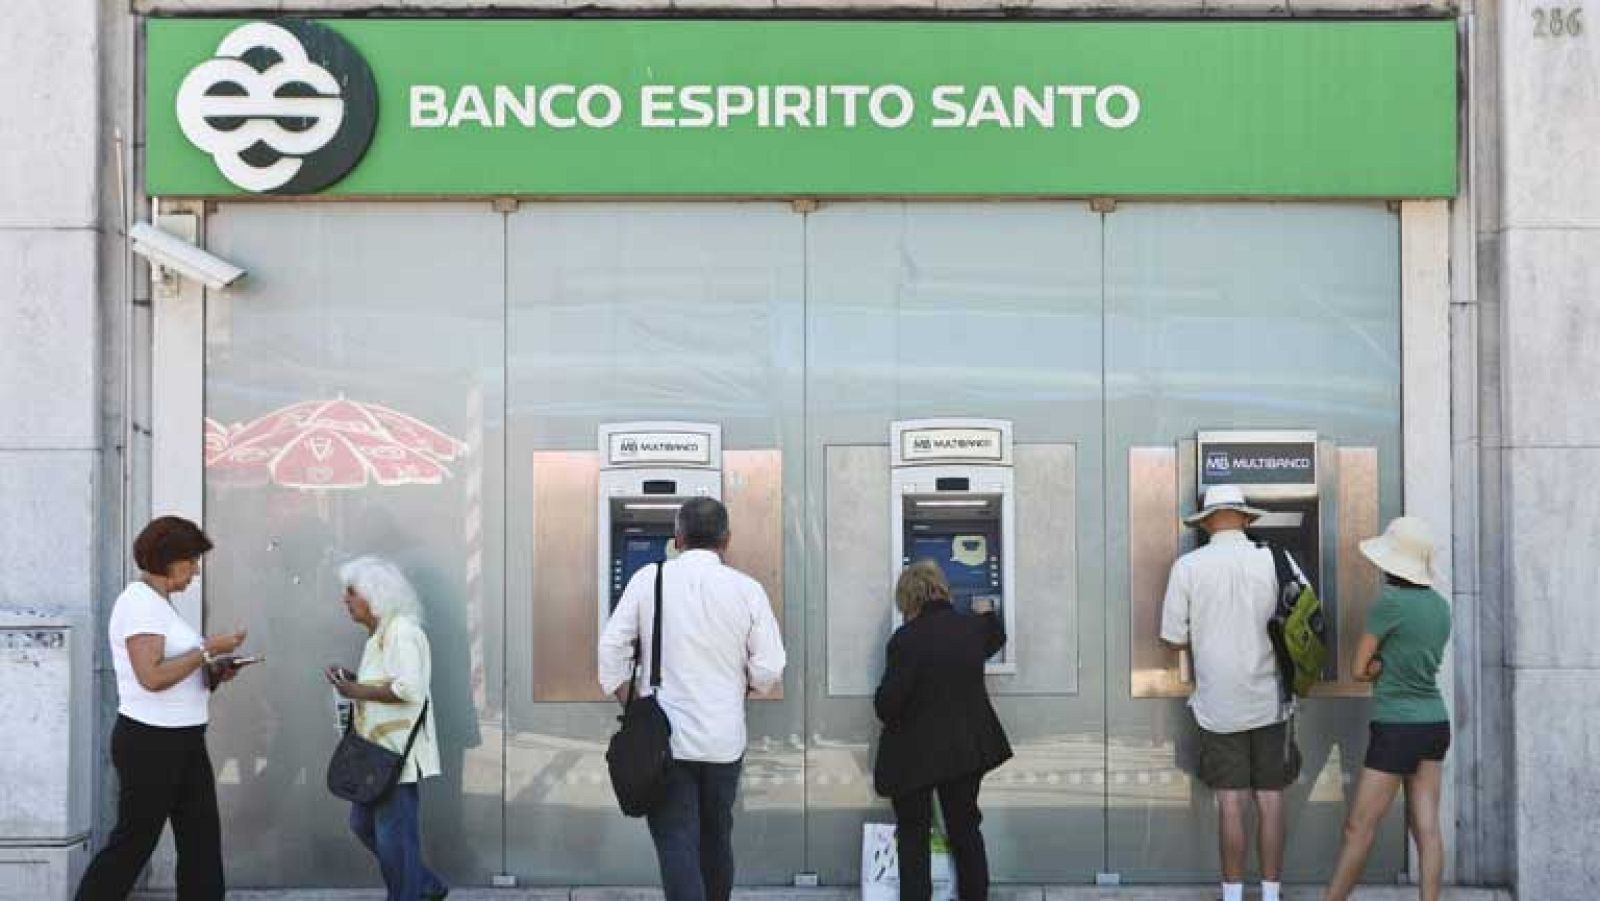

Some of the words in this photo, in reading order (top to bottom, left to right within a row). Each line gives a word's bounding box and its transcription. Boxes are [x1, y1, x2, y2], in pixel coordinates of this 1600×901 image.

[1532, 7, 1583, 38] 286
[409, 84, 622, 128] BANCO
[640, 84, 914, 128] ESPIRITO
[931, 84, 1140, 128] SANTO
[640, 442, 699, 452] MULTIBANCO
[1232, 457, 1311, 469] MULTIBANCO
